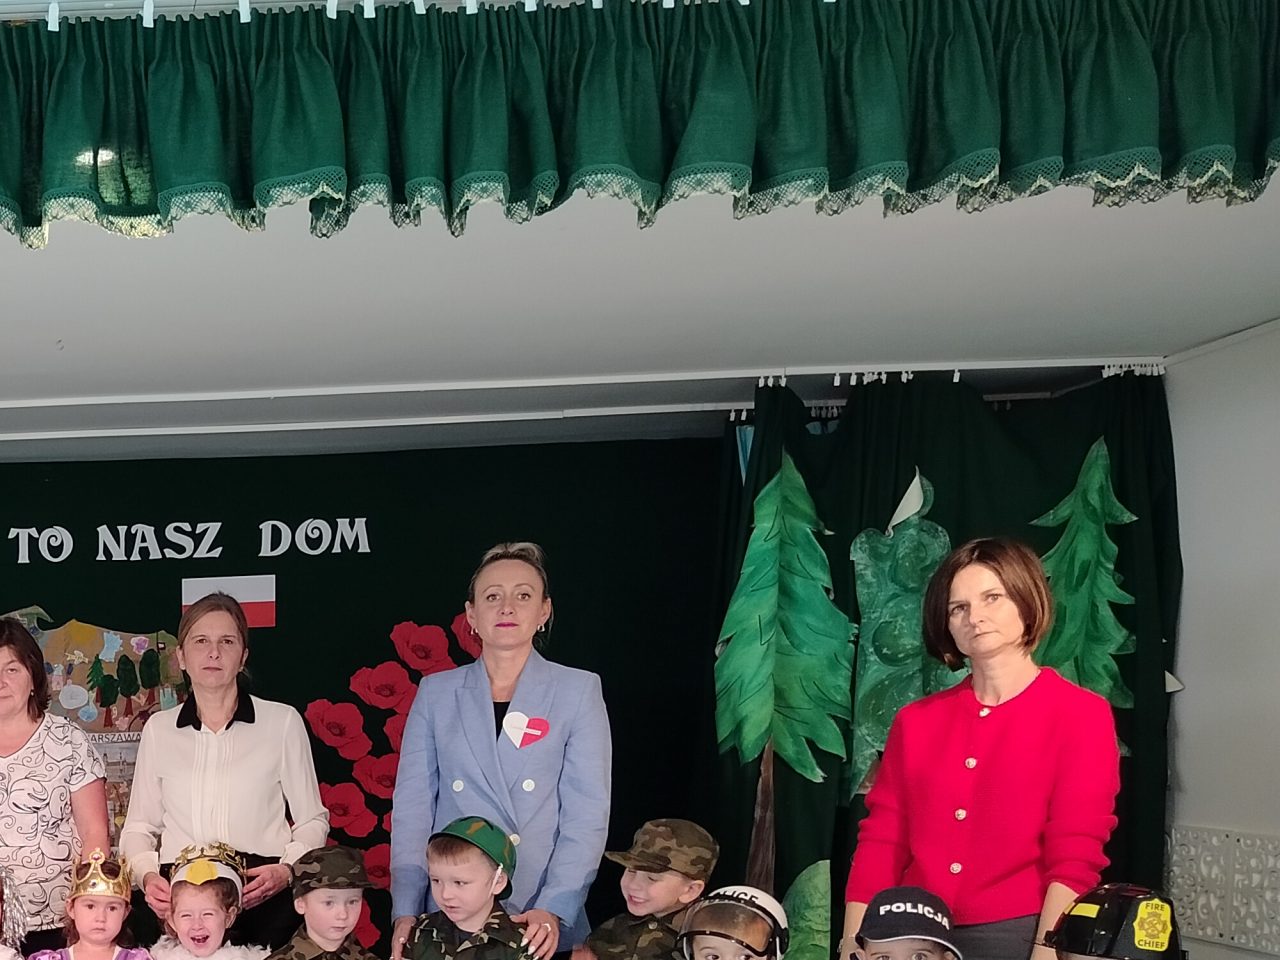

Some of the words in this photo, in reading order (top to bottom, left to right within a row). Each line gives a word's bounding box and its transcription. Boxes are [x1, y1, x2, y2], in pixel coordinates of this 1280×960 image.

[8, 526, 74, 564] TO
[96, 521, 223, 561] NASZ
[258, 517, 371, 557] DOM
[88, 733, 141, 742] ARSZAWA
[1145, 903, 1166, 911] FIRE
[879, 902, 950, 930] POLICJA
[1137, 939, 1166, 949] CHIEF
